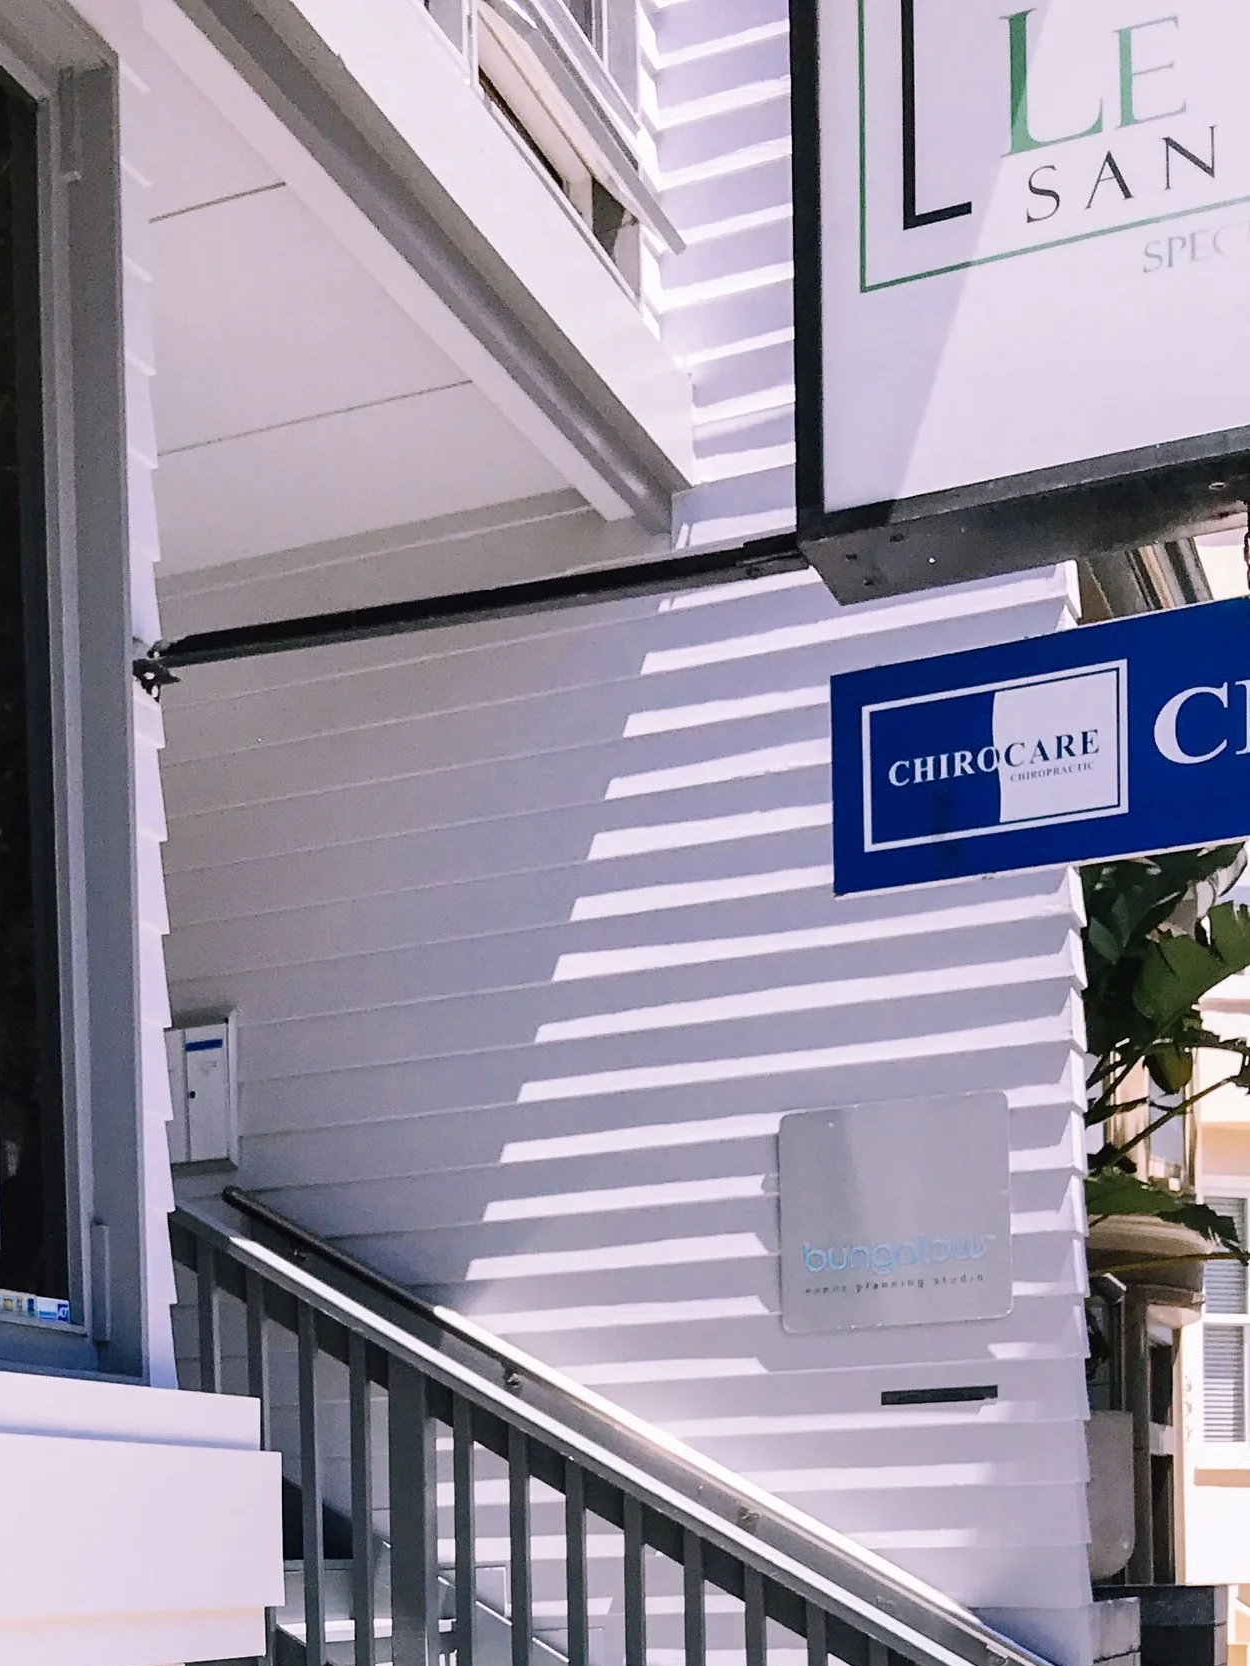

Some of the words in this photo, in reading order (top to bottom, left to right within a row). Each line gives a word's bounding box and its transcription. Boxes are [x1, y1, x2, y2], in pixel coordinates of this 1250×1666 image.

[1000, 8, 1187, 157] LE
[1025, 125, 1217, 224] SAN
[1142, 218, 1250, 274] SPEC
[887, 727, 1101, 788] CHIROCARE
[1009, 761, 1094, 783] CHIROPRACTIC
[802, 1234, 987, 1277] bungalow
